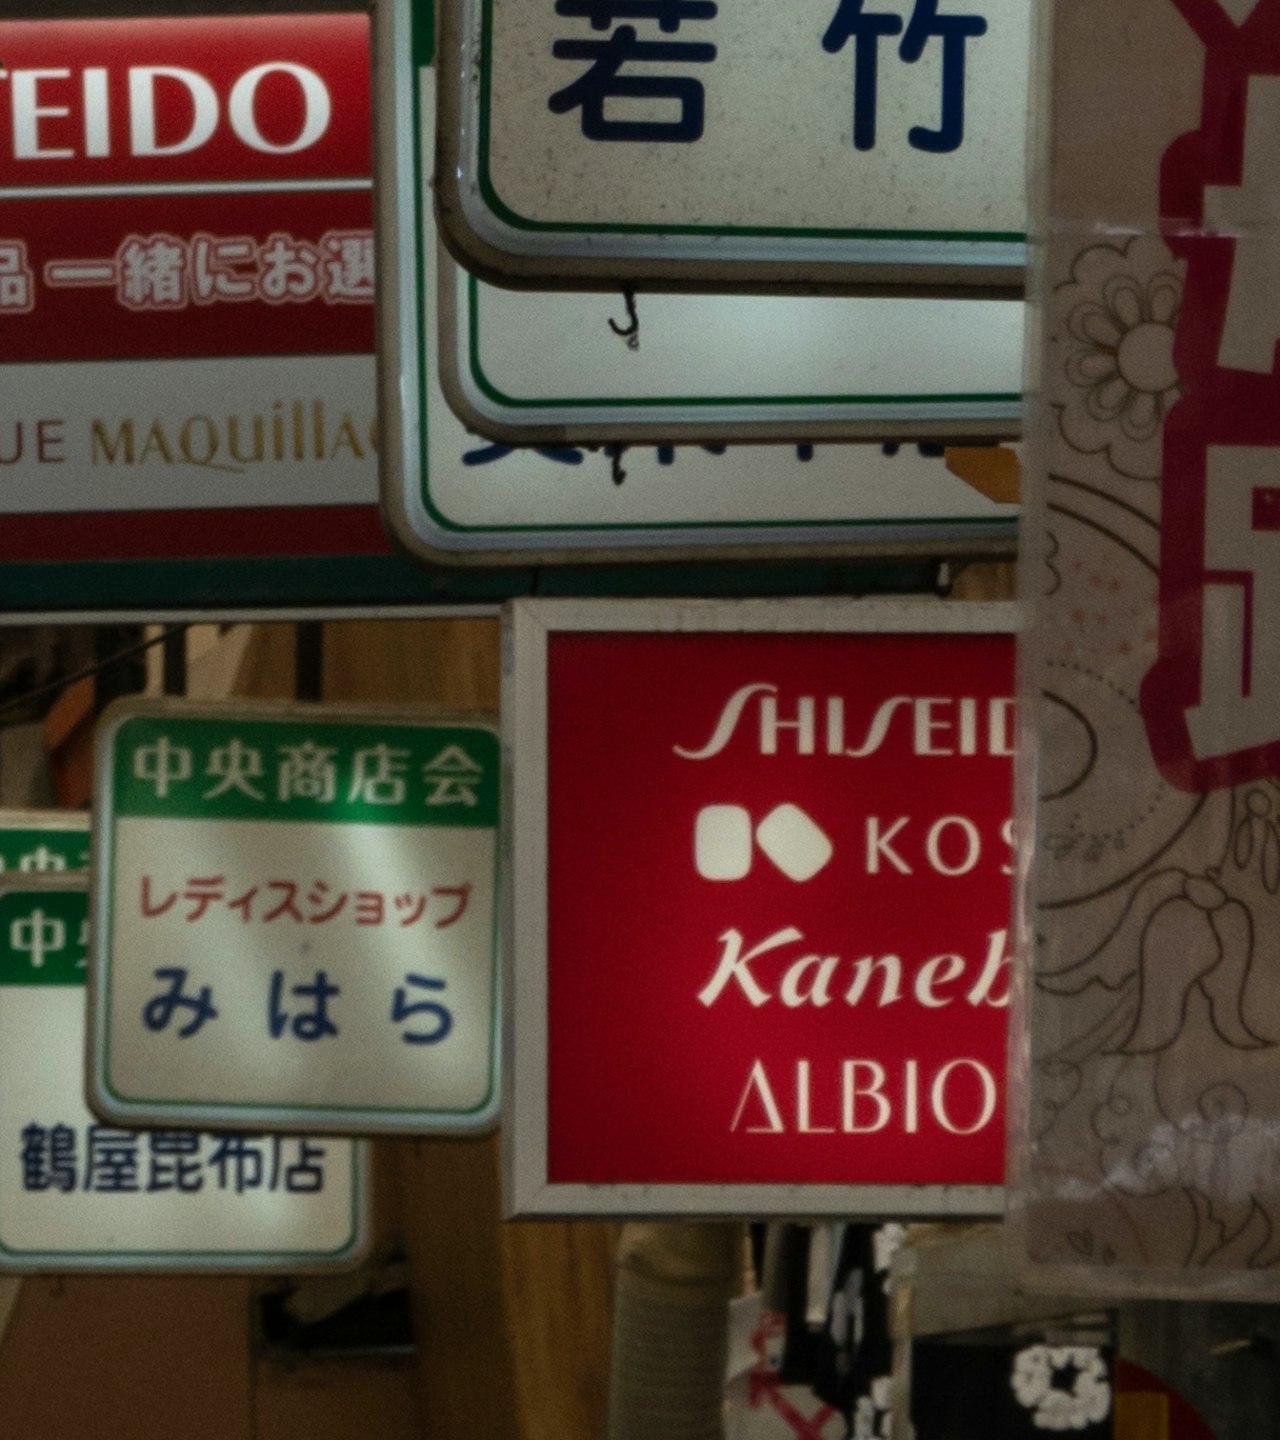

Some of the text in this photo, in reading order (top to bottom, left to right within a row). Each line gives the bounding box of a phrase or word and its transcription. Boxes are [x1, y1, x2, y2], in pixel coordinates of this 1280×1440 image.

[132, 735, 485, 808] 中央商店会
[142, 968, 454, 1047] みはら
